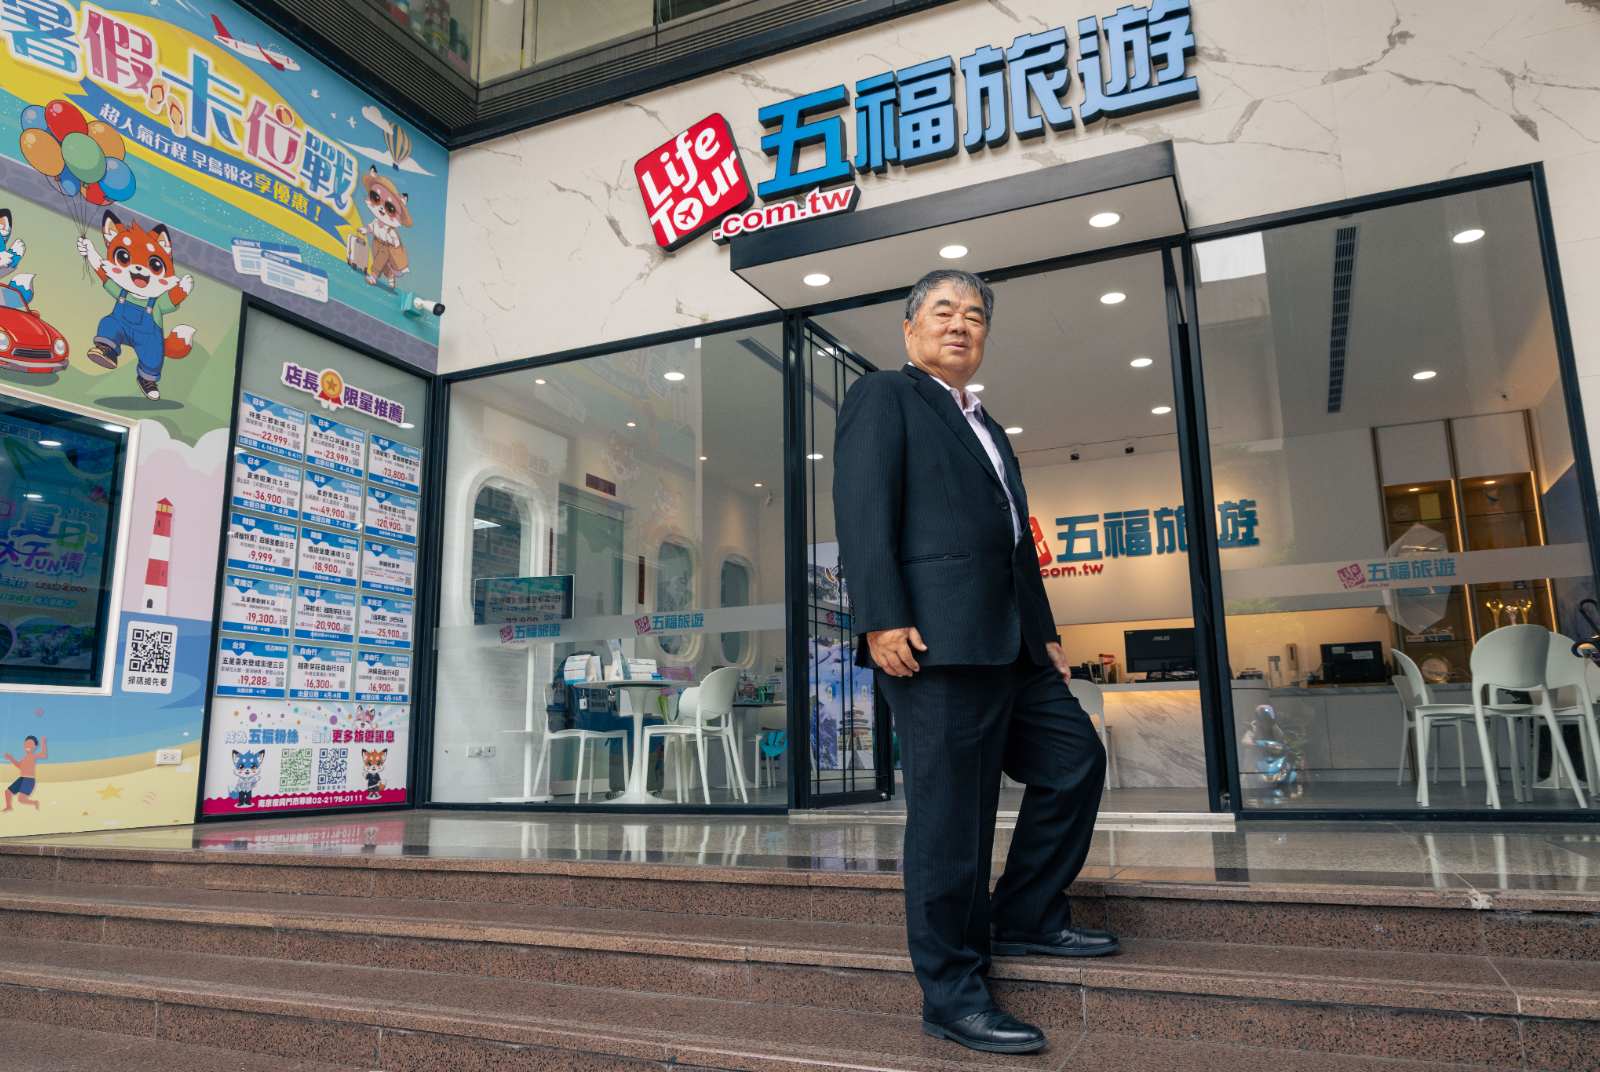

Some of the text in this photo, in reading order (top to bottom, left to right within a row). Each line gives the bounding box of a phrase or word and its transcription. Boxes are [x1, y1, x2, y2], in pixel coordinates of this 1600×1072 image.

[0, 0, 355, 210] 暑假卡位戰
[757, 0, 1199, 199] 五福旅遊
[100, 103, 187, 163] 超人氣行程
[642, 127, 721, 208] Life
[651, 150, 740, 244] Tour
[713, 188, 852, 238] .com.tw
[285, 364, 319, 393] 店長
[343, 387, 404, 423] 限量推薦
[326, 450, 349, 463] 23,999
[255, 490, 282, 504] 36,900
[251, 550, 273, 563] 9,999
[315, 562, 338, 574] 18,900
[1367, 558, 1456, 582] 五福旅遊
[248, 611, 274, 624] 19,300
[652, 612, 704, 630] 五福旅遊
[316, 620, 341, 632] 20,900
[240, 675, 267, 686] 19,288
[306, 679, 330, 689] 16,300
[370, 683, 392, 692] 16,900
